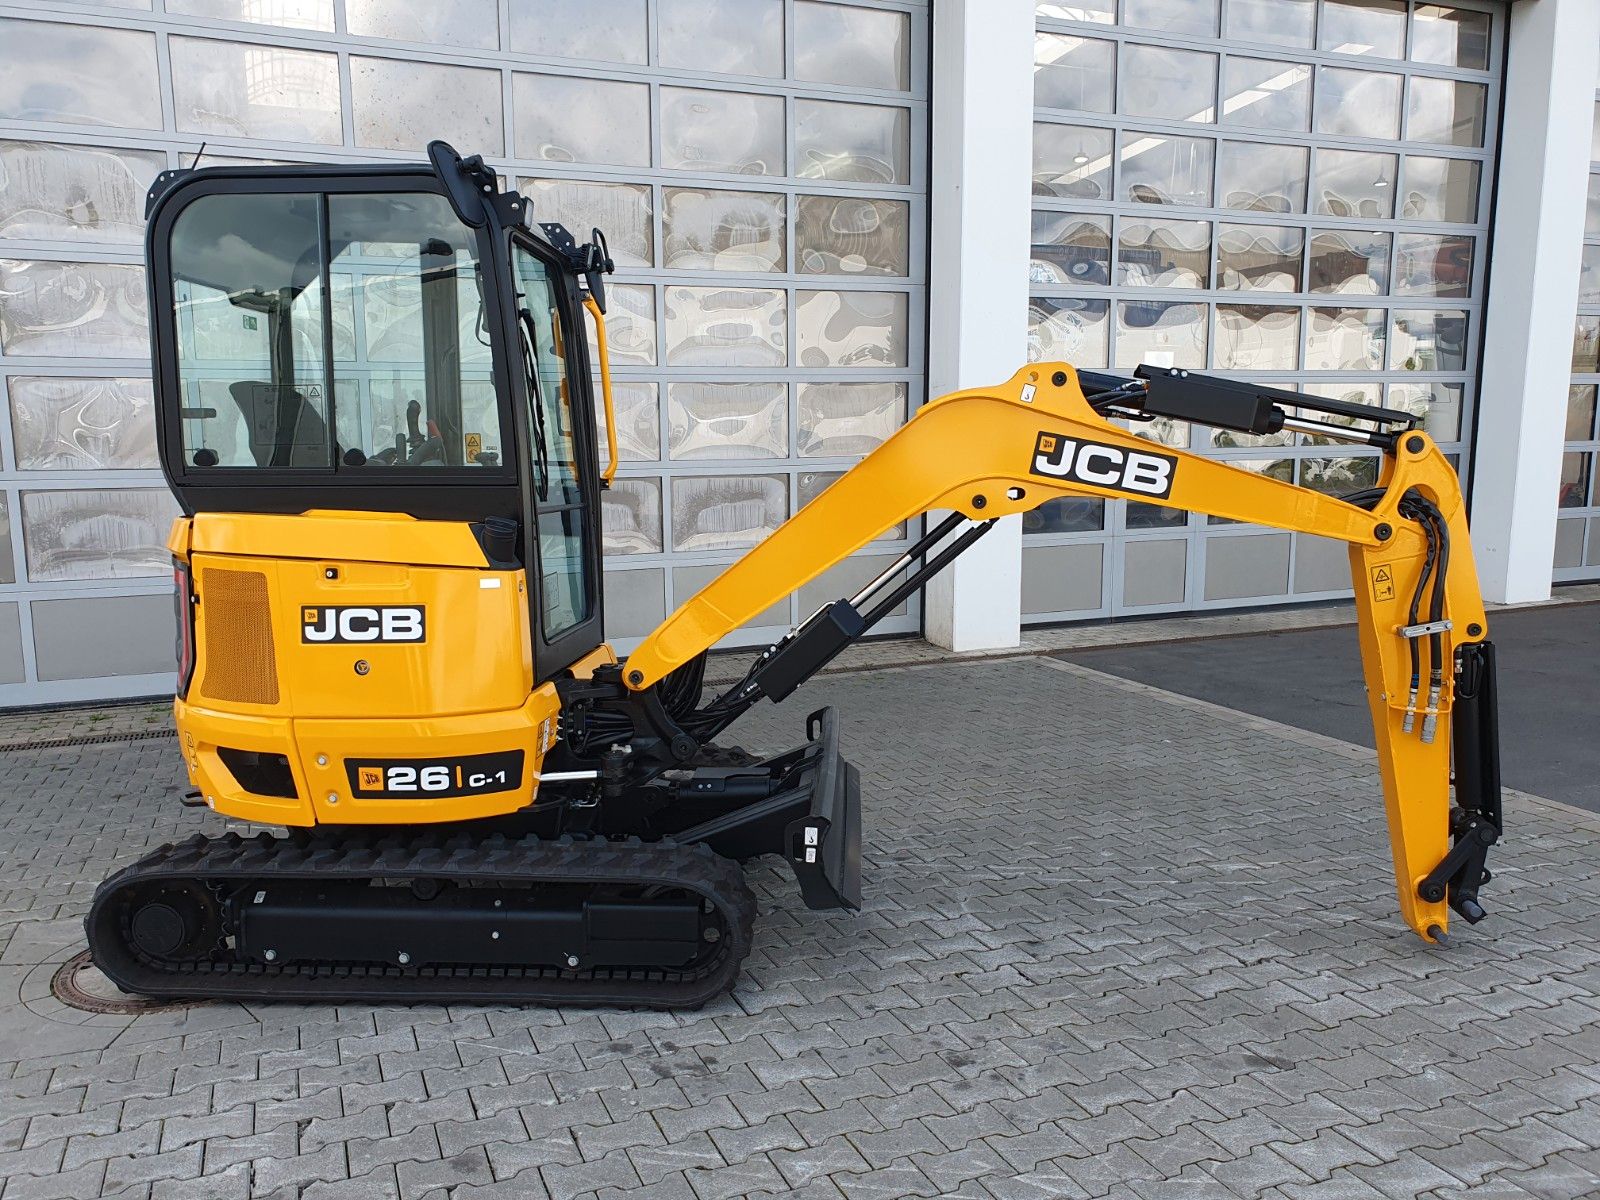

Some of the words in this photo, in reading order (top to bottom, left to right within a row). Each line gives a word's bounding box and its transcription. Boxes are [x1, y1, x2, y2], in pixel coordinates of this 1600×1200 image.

[1035, 440, 1171, 494] JCB
[304, 608, 423, 641] JCB
[387, 766, 450, 791] 26
[468, 770, 506, 787] C-1
